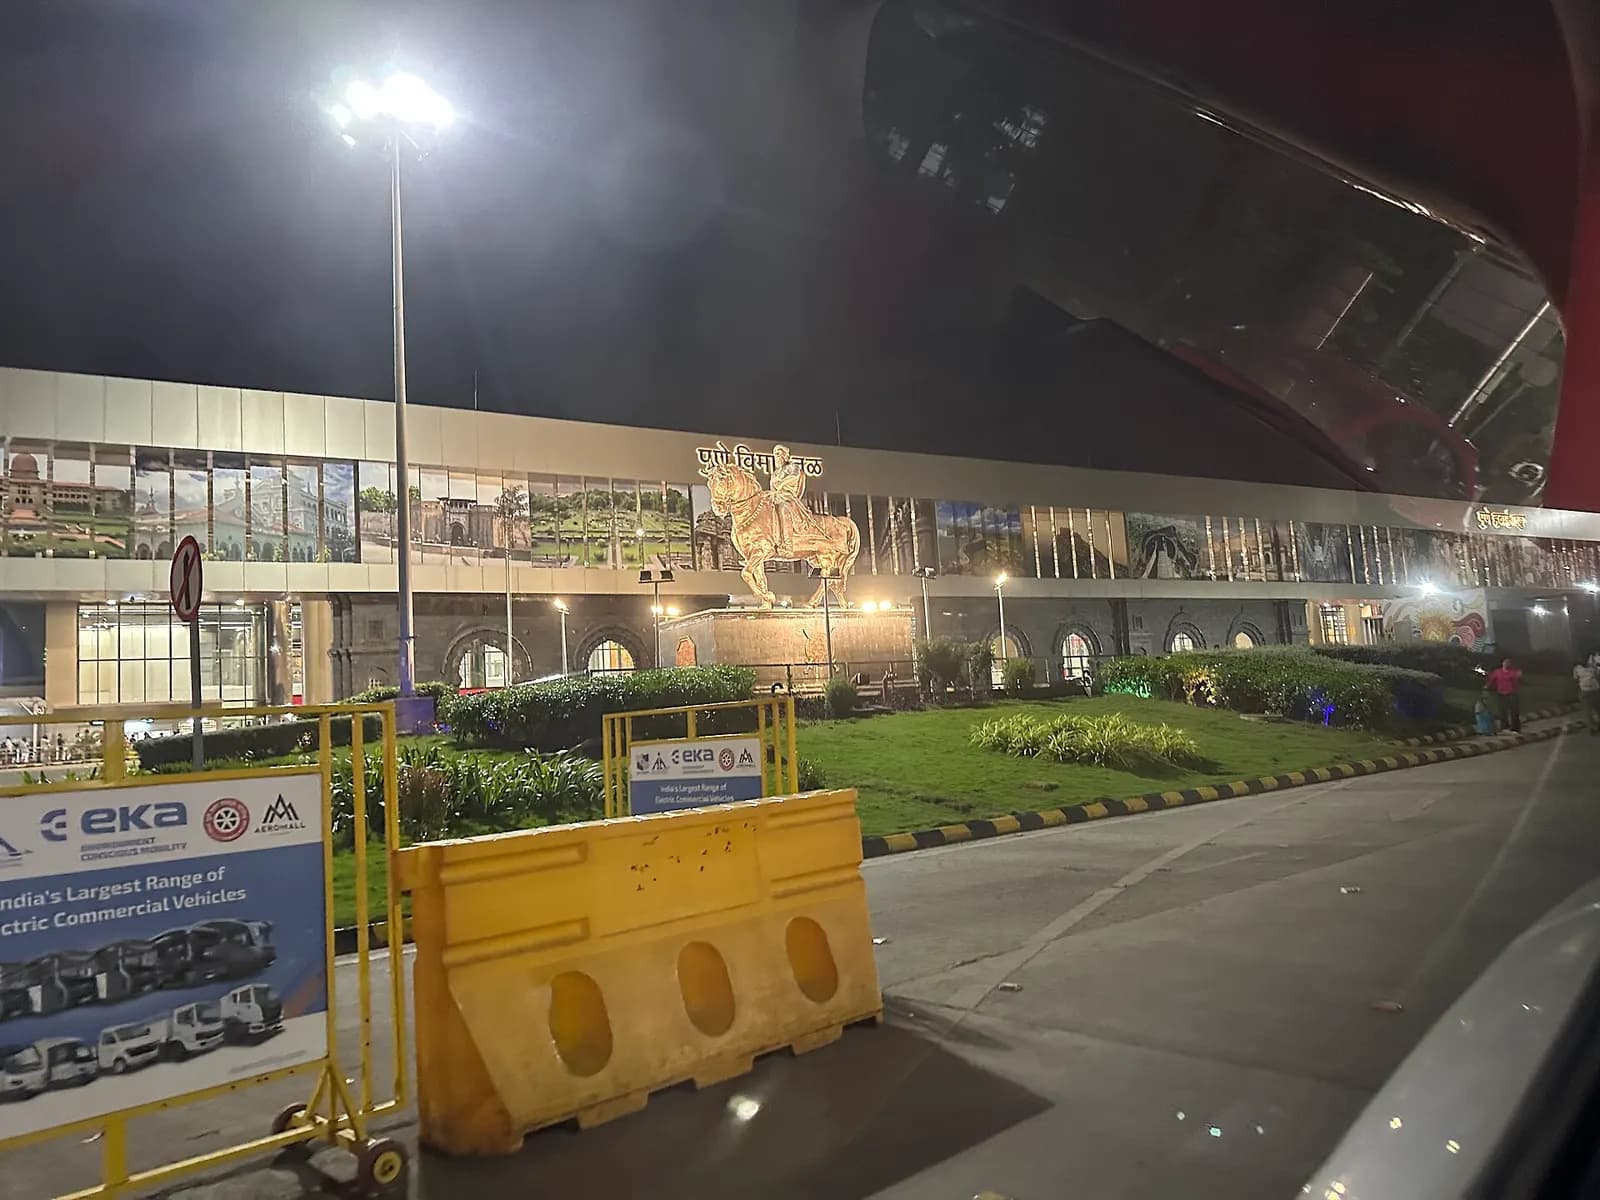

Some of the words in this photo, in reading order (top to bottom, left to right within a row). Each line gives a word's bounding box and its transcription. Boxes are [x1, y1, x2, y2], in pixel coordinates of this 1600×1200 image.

[81, 801, 188, 835] eka
[66, 879, 142, 904] Largest
[145, 871, 203, 894] Range
[206, 866, 226, 882] of
[54, 899, 170, 929] Commercial
[172, 887, 247, 909] Vehicles
